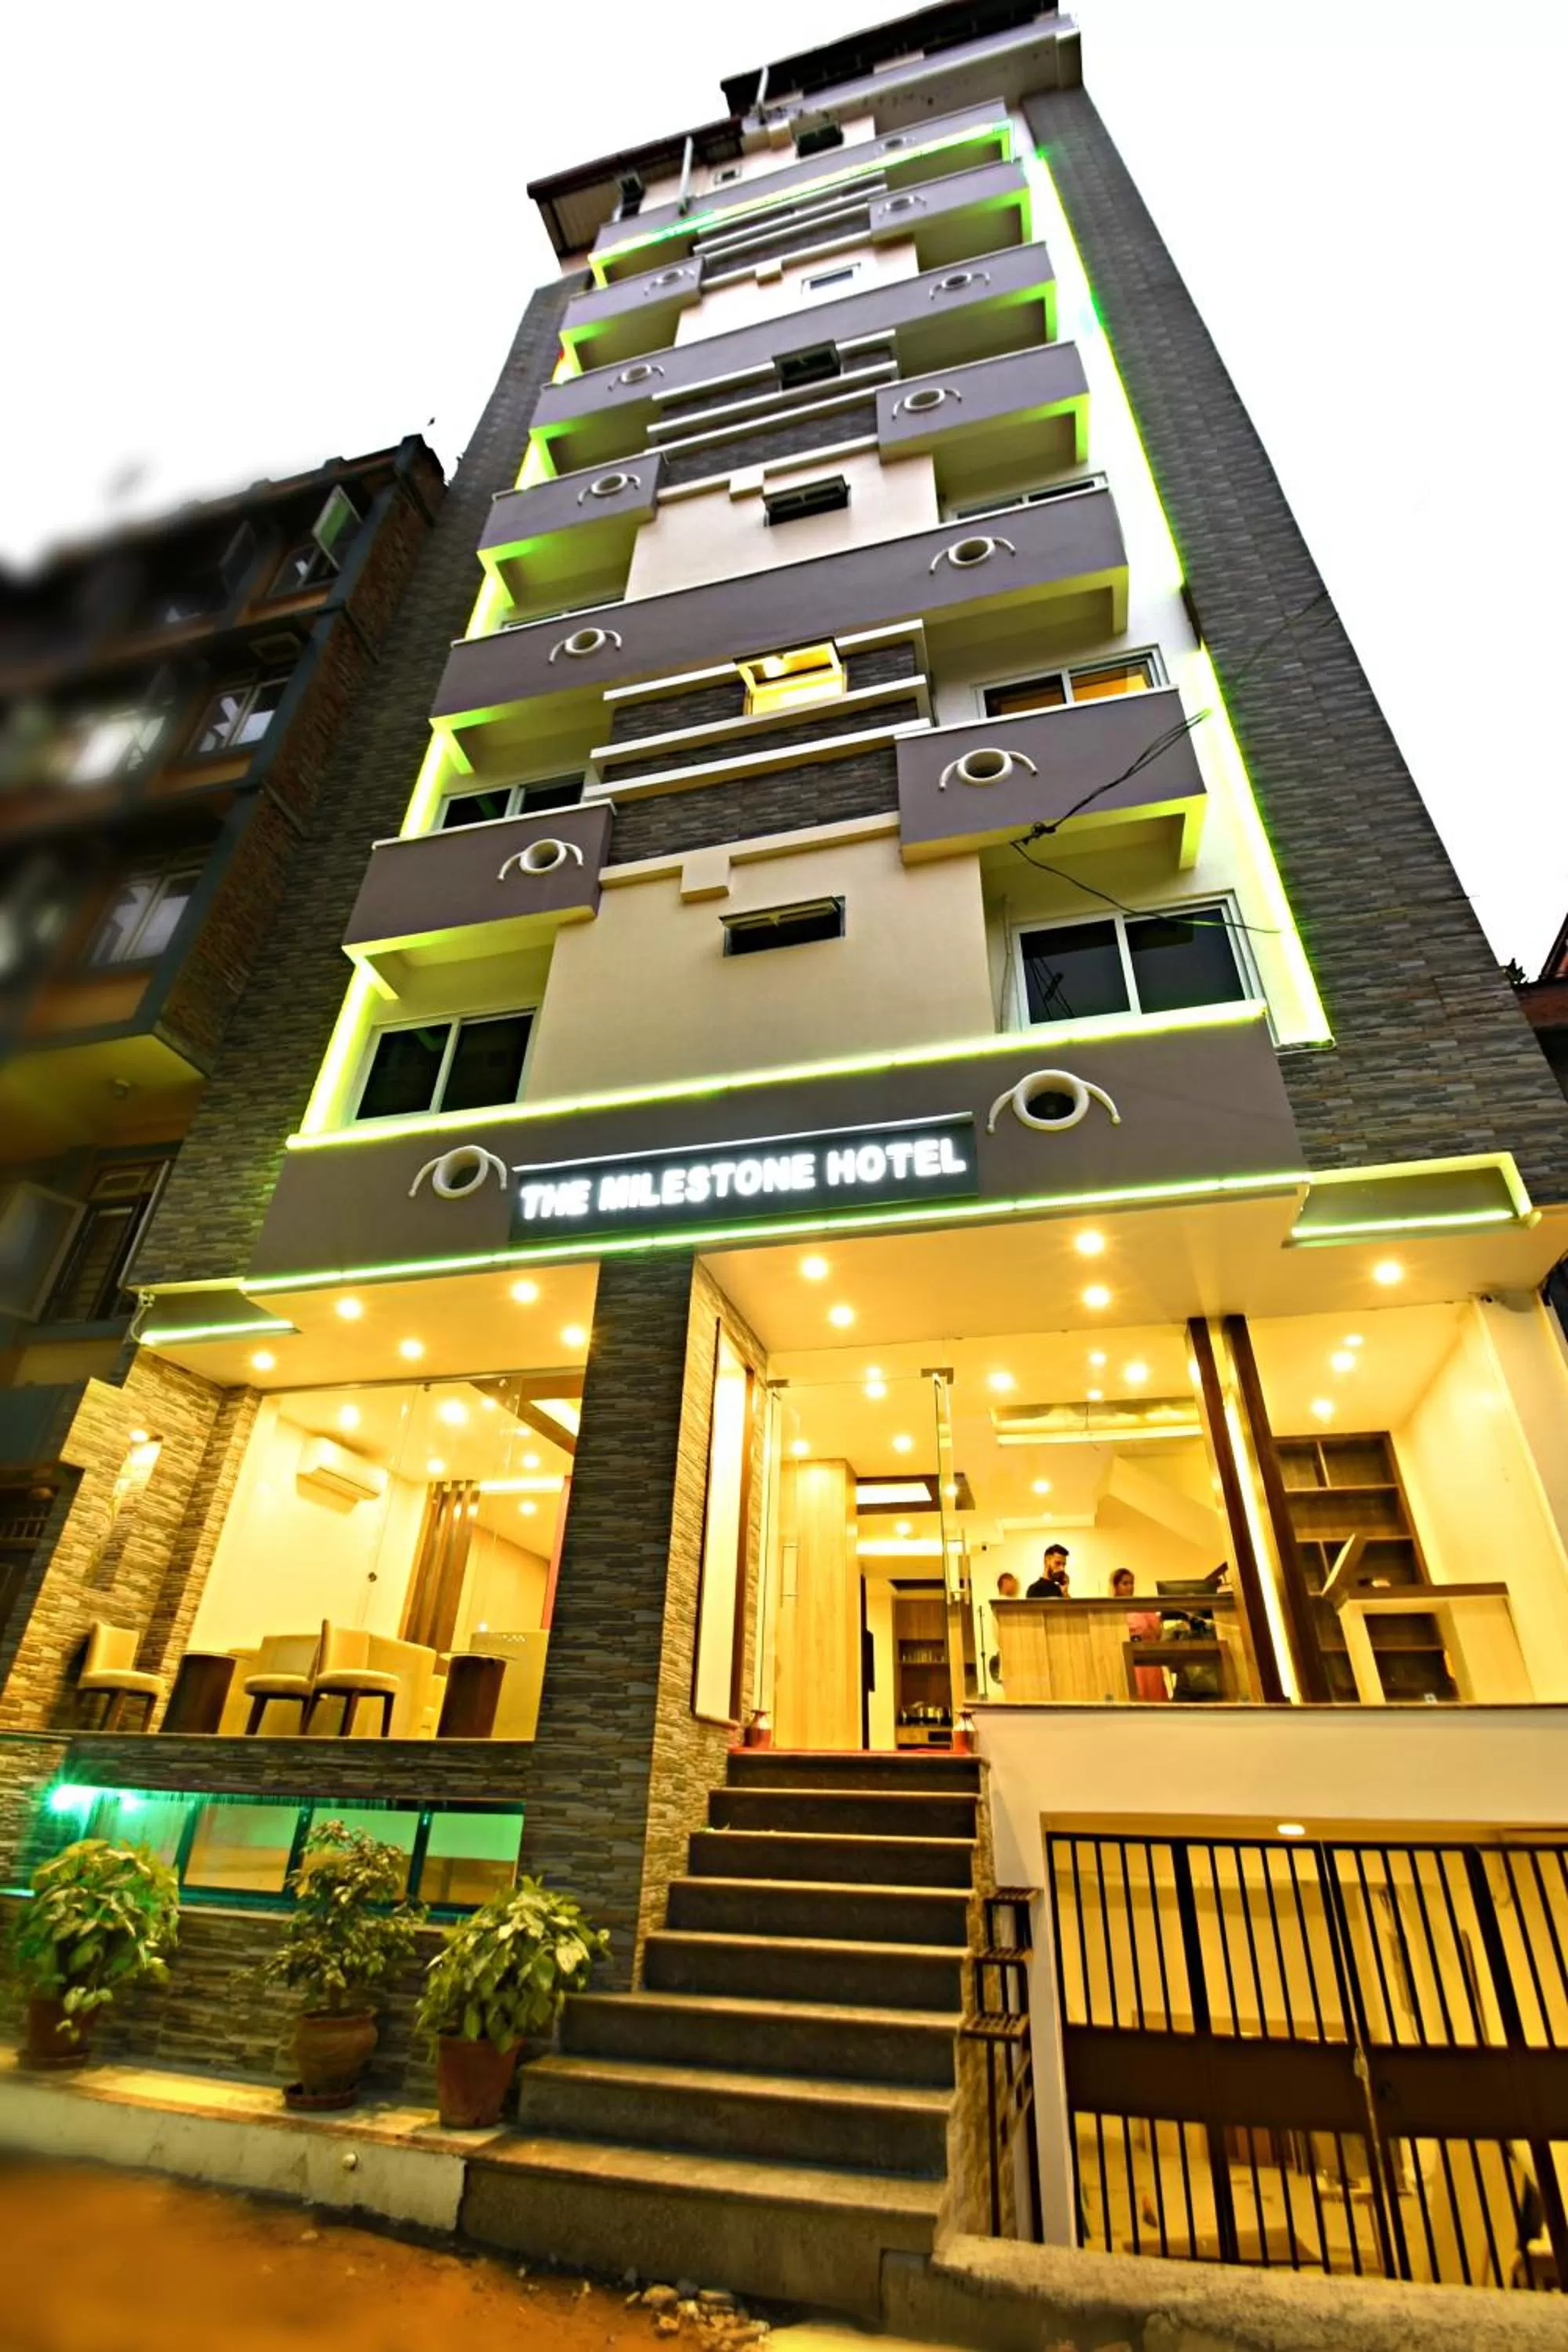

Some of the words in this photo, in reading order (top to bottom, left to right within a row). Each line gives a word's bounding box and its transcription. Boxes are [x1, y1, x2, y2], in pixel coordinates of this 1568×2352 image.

[520, 1179, 592, 1220] THE
[597, 1153, 816, 1211] MILESTONE
[826, 1138, 967, 1186] HOTEL
